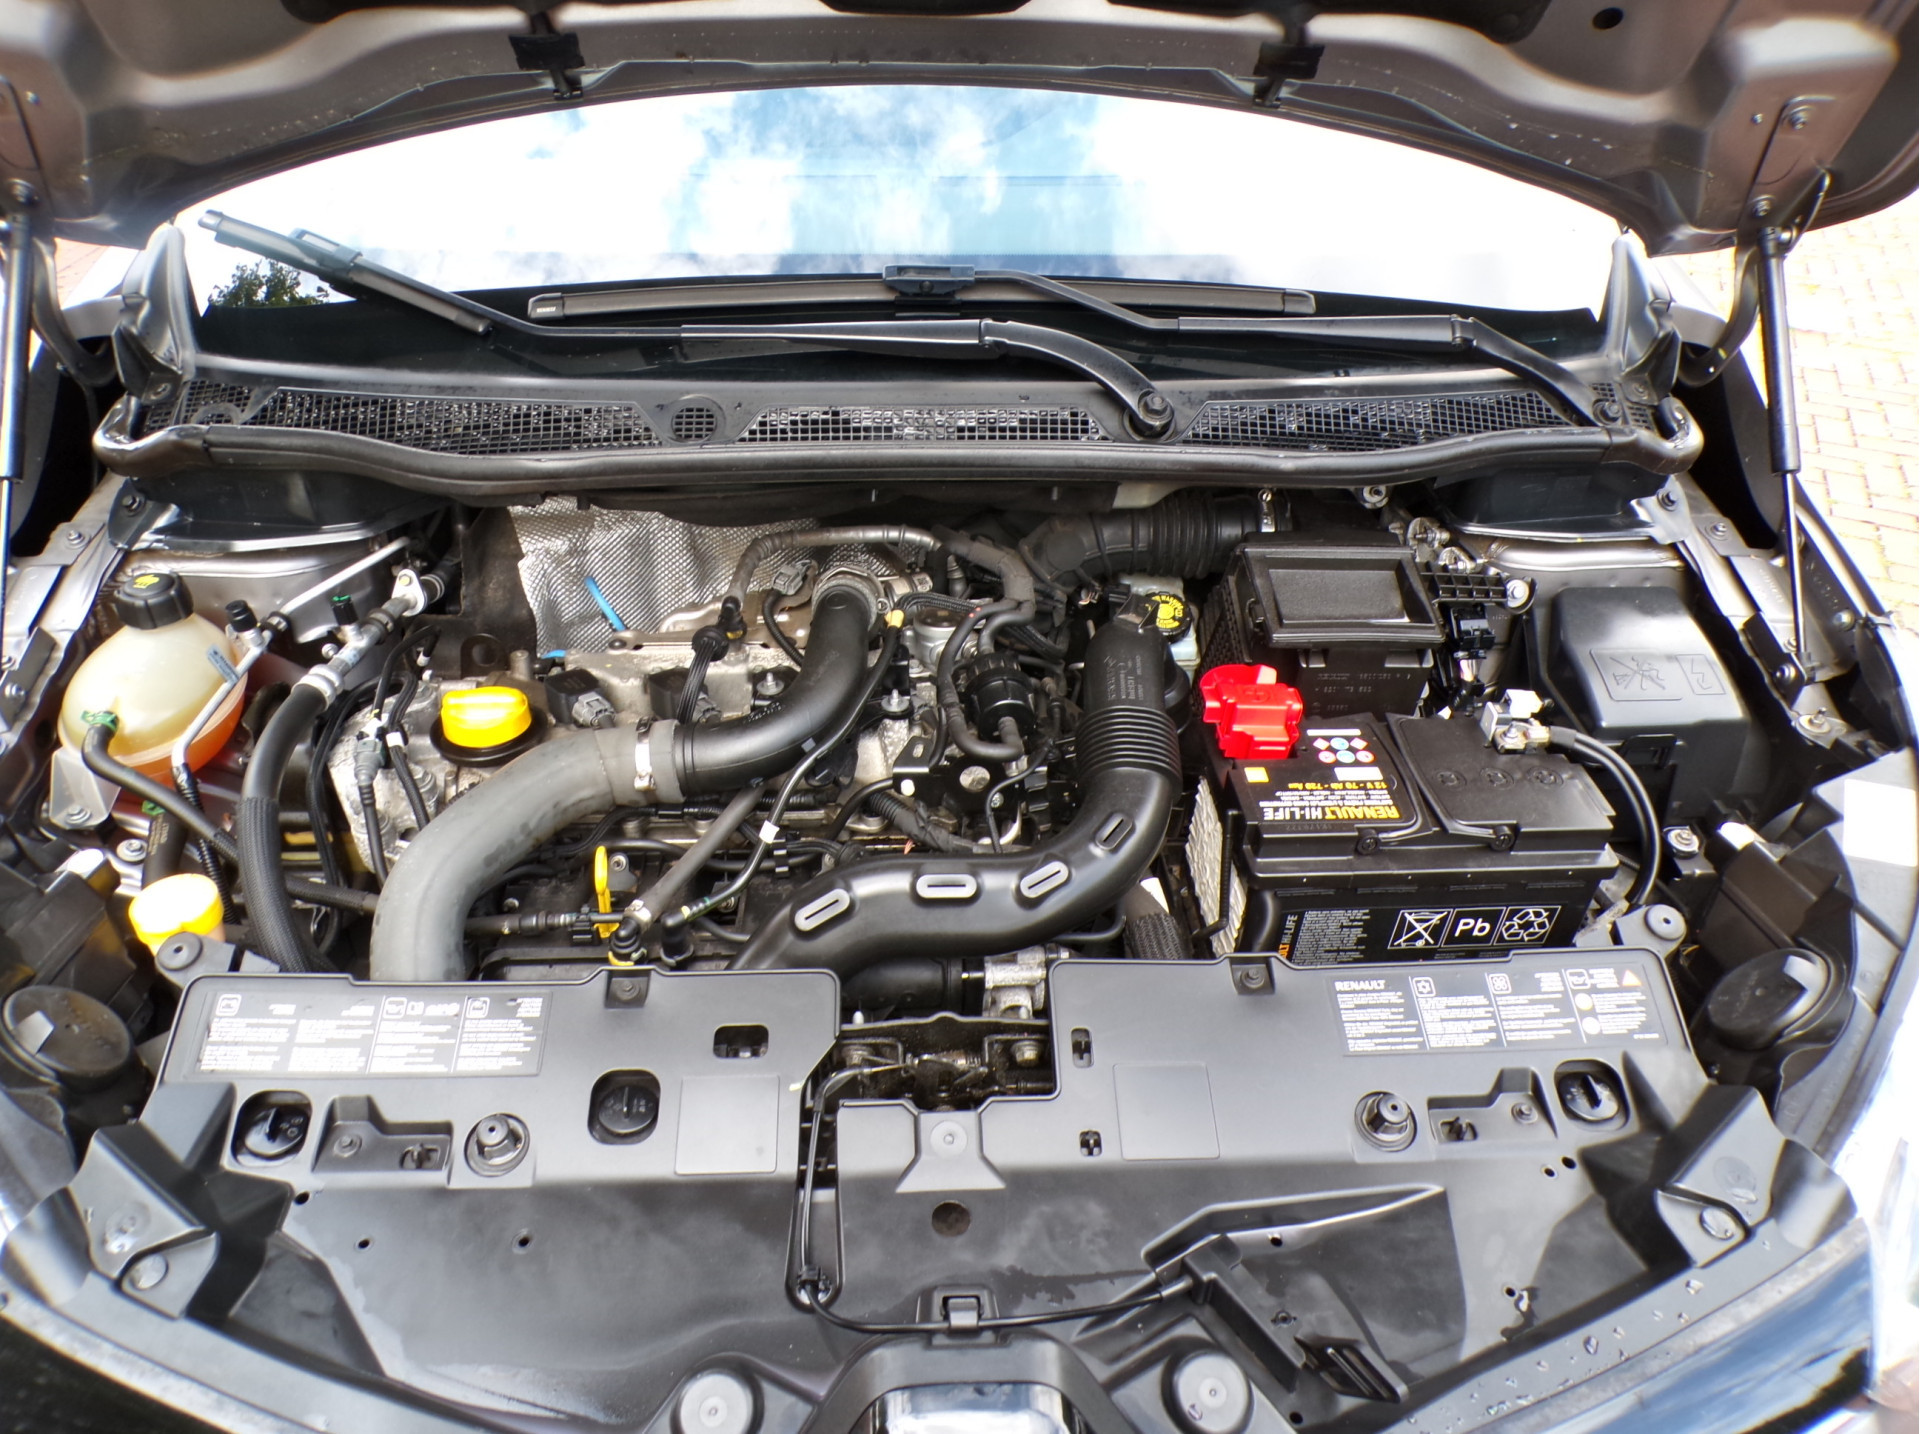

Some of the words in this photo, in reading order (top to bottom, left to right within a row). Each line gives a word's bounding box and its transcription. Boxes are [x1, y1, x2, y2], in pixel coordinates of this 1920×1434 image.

[1263, 807, 1323, 820] HI-LIFE
[1324, 805, 1400, 819] RENAULT
[1454, 917, 1491, 937] Pb
[1334, 980, 1386, 991] RENAULT
